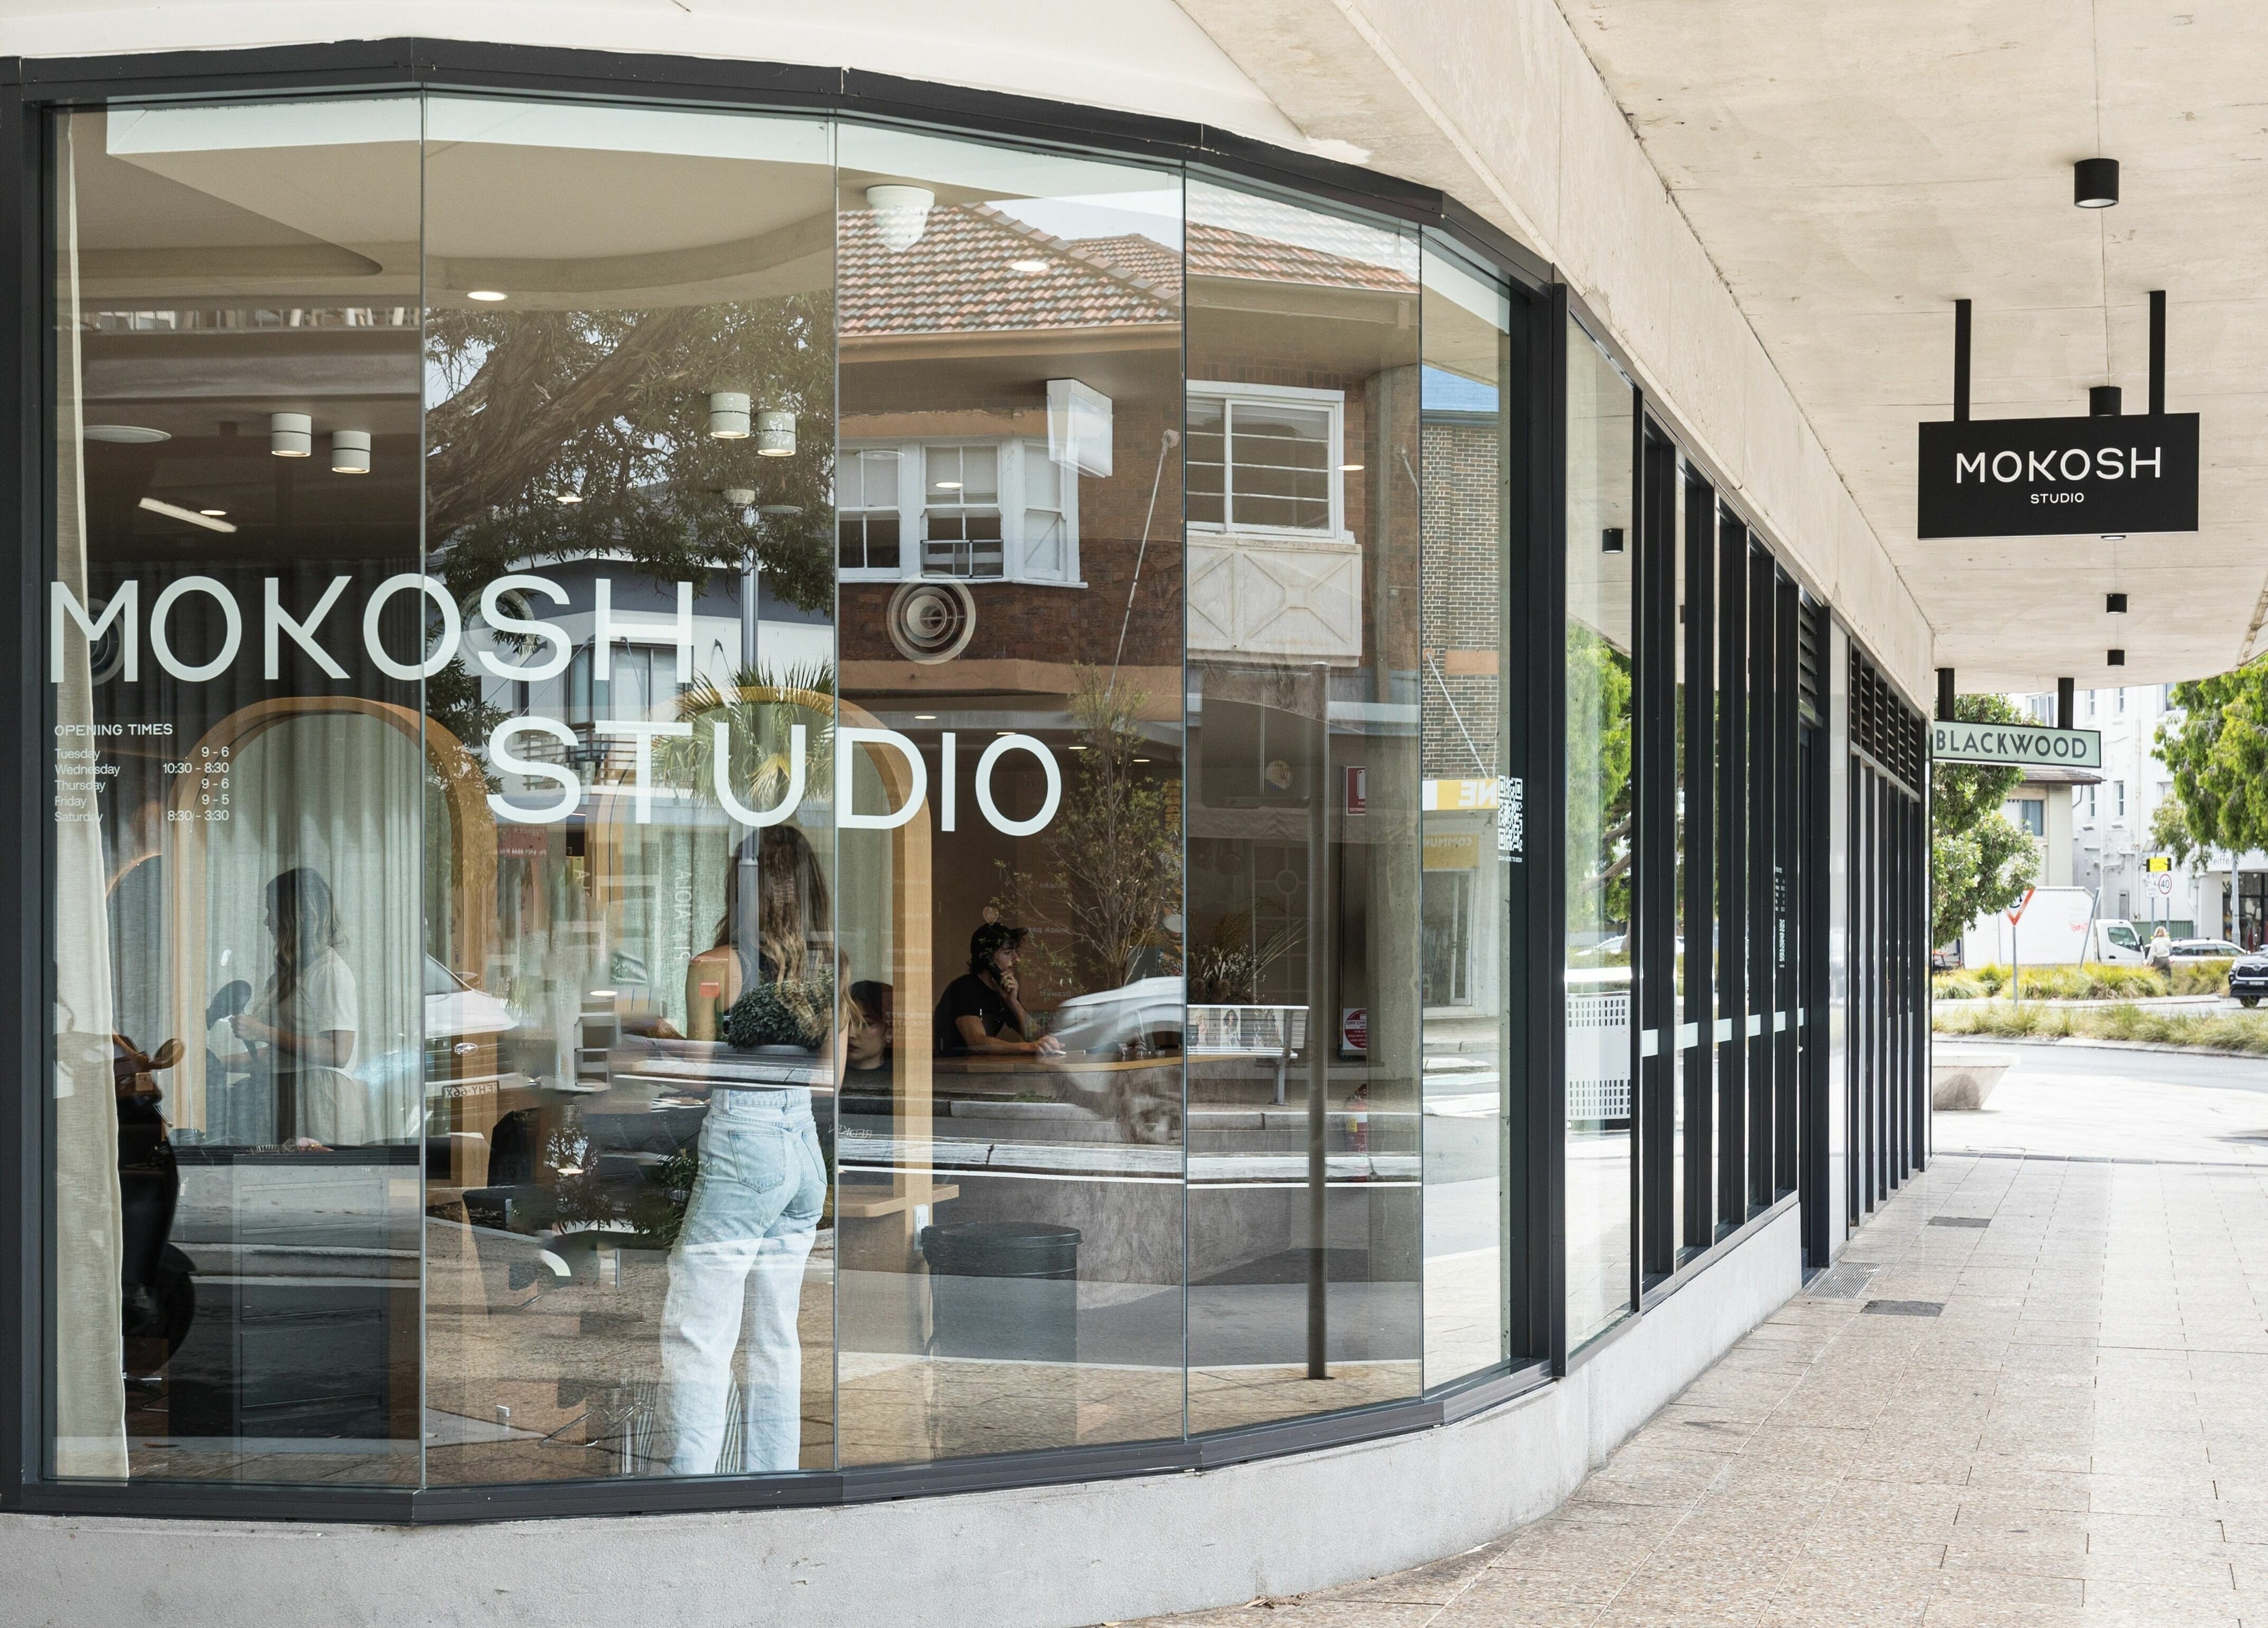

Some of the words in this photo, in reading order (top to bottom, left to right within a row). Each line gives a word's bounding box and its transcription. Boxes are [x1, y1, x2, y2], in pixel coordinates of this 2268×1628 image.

[1956, 447, 2161, 484] MOKOSH
[2030, 492, 2084, 504] STUDIO
[51, 573, 693, 683] MOKOSH
[54, 724, 123, 736] OPENING
[128, 723, 173, 735] TIMES
[1936, 729, 2087, 759] BLACKWOOD
[54, 748, 100, 761] Tuesday
[201, 746, 209, 757] 9
[221, 746, 229, 757] 6
[54, 764, 120, 777] Wednesday
[162, 763, 192, 774] 10:30
[204, 762, 229, 773] 8:30
[486, 716, 1061, 836] STUDIO
[54, 780, 105, 793] Thursday
[201, 778, 209, 789] 9
[221, 778, 229, 789] 6
[54, 796, 87, 808] Friday
[201, 795, 209, 805] 9
[221, 795, 229, 805] 5
[54, 812, 103, 823] Saturday
[167, 810, 192, 821] 8:30
[204, 810, 229, 821] 3:30
[2161, 879, 2170, 888] 40
